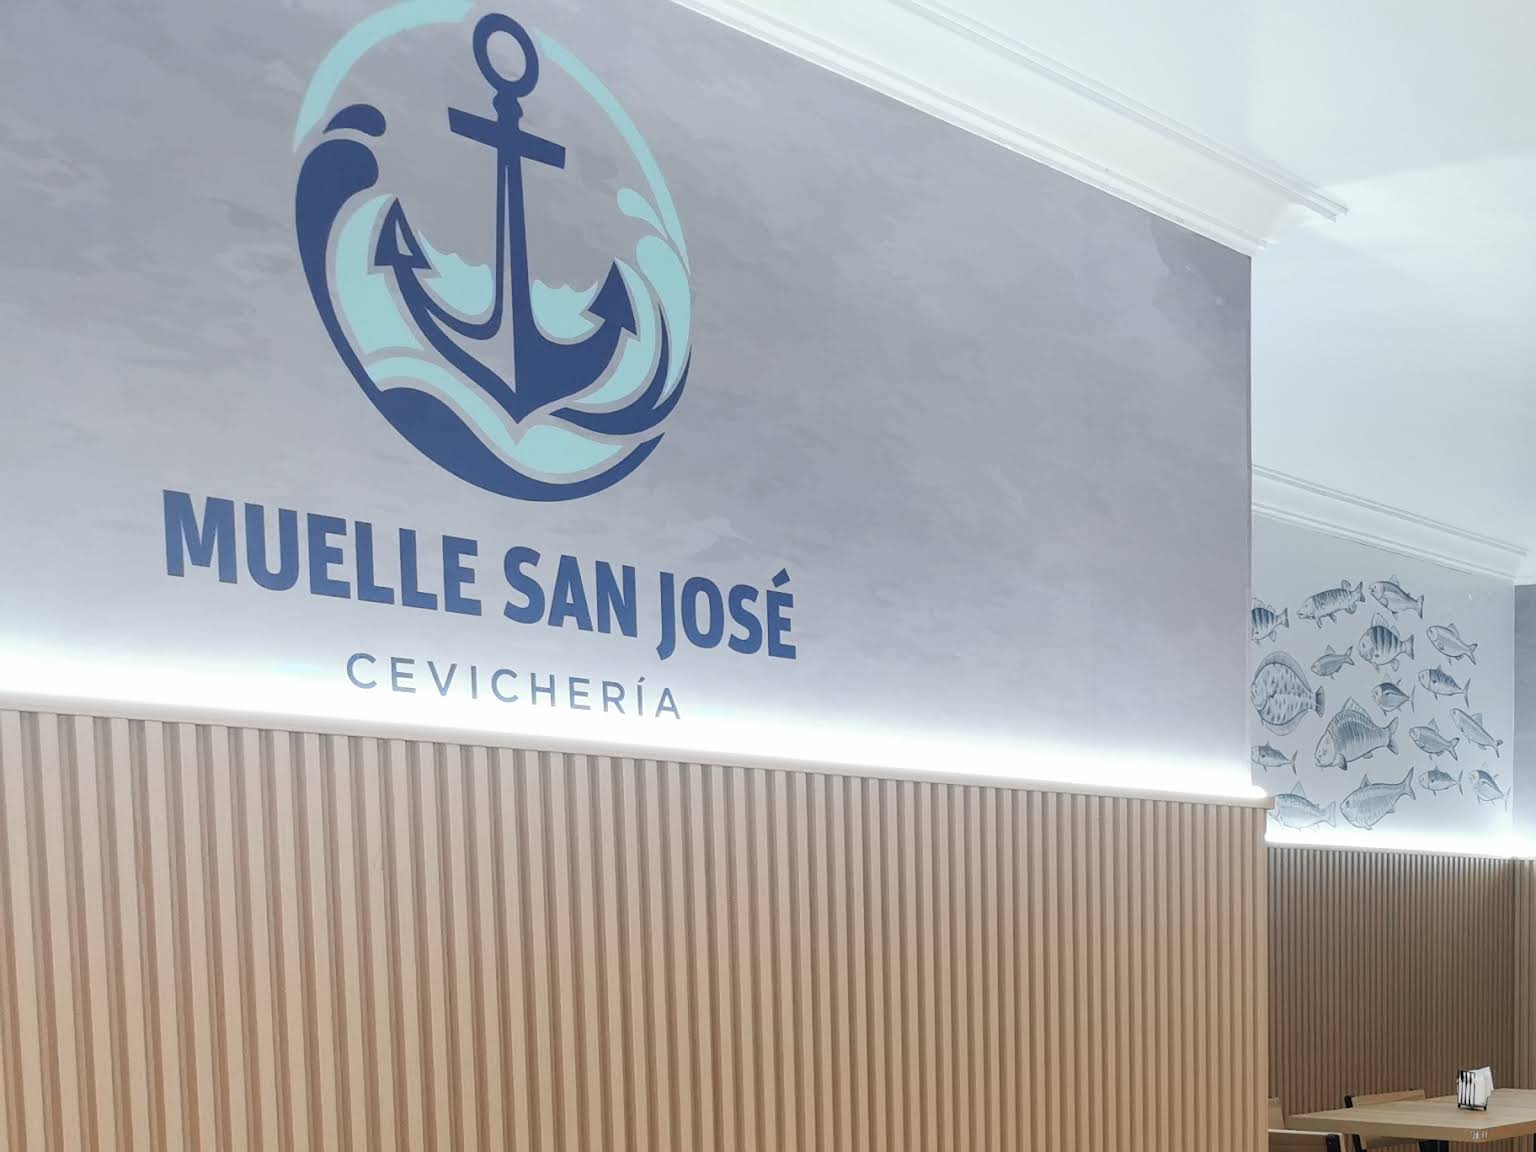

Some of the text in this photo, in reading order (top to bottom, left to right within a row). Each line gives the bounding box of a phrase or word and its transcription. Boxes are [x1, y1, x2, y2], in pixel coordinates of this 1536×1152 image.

[163, 489, 798, 661] MUELLE SAN JOSÉ
[345, 651, 682, 721] CEVICHERÍA
